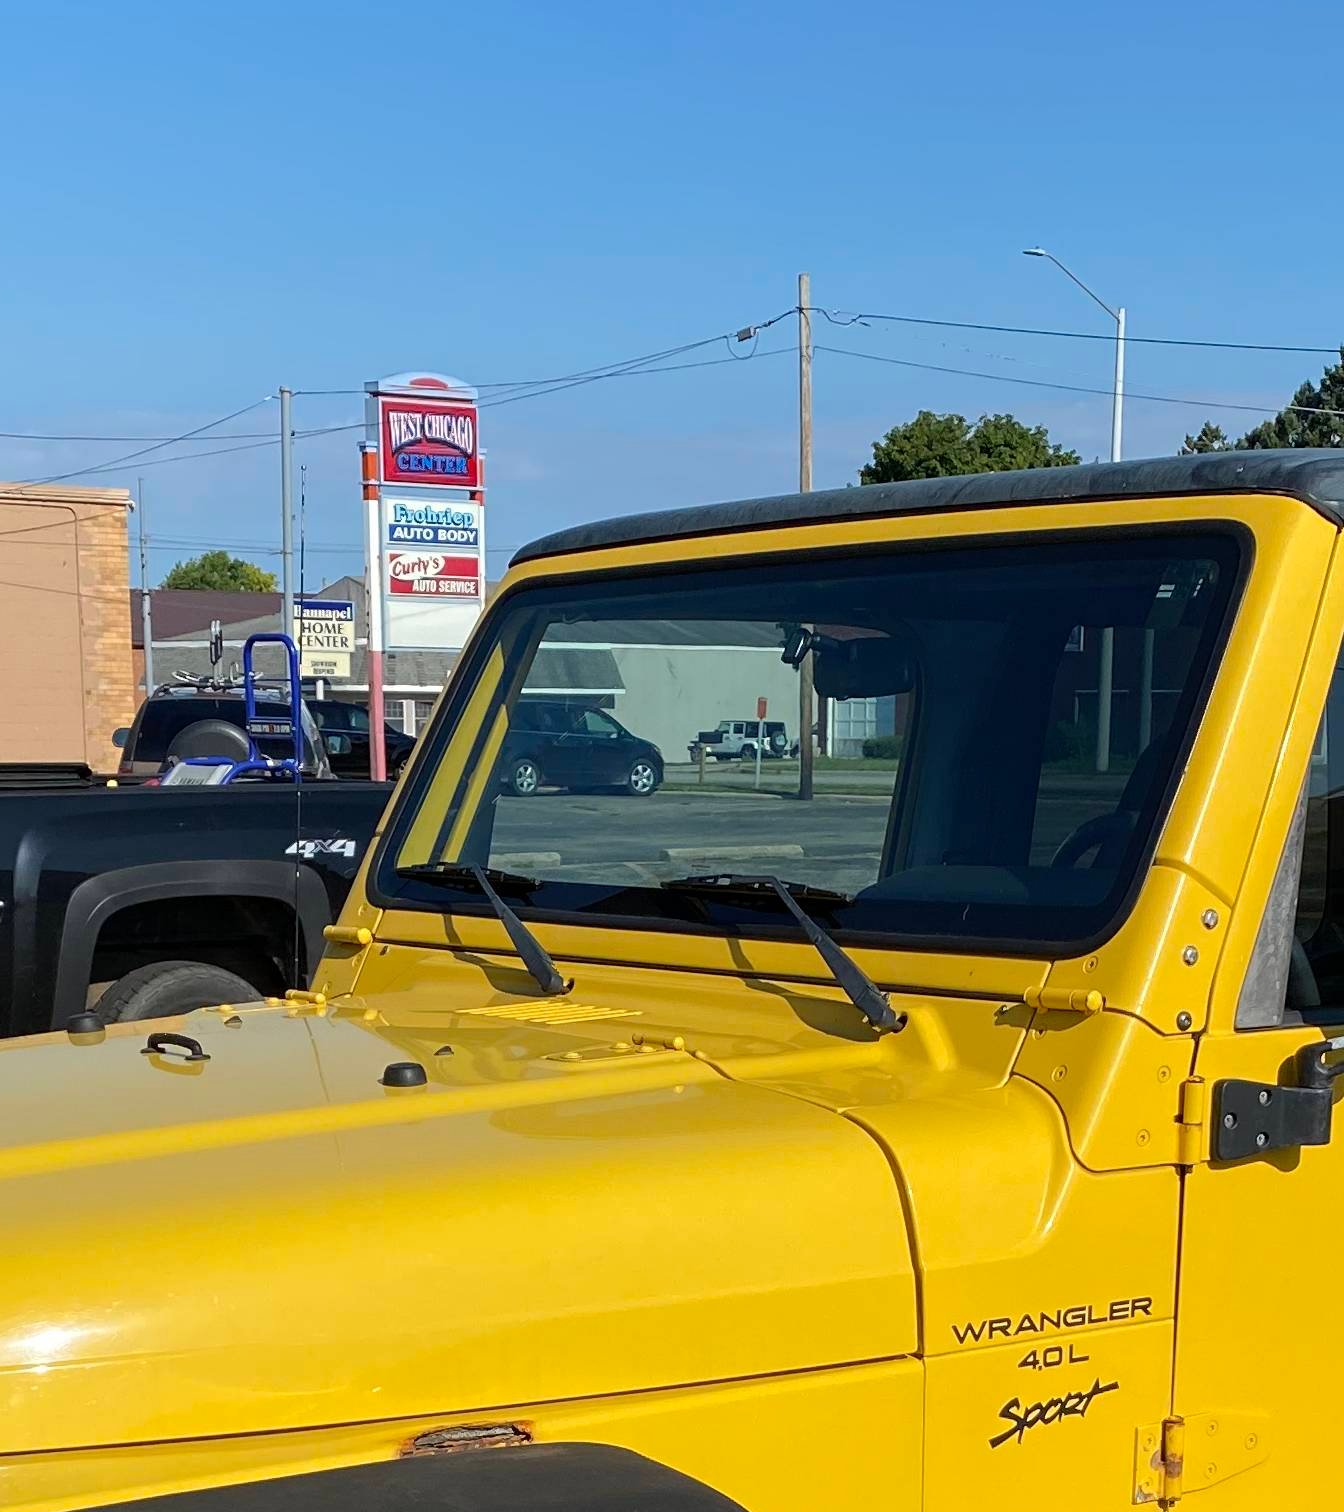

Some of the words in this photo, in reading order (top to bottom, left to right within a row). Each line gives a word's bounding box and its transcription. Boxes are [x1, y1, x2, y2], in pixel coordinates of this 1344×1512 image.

[389, 411, 423, 452] WEST
[424, 413, 473, 454] CHICAGO
[397, 453, 468, 473] CENTER
[393, 526, 434, 540] AUTO
[437, 528, 477, 543] BODY
[412, 580, 437, 593] AUTO
[438, 580, 476, 594] SERVICE
[302, 621, 345, 635] HOME
[951, 1297, 1153, 1345] WRANGLER
